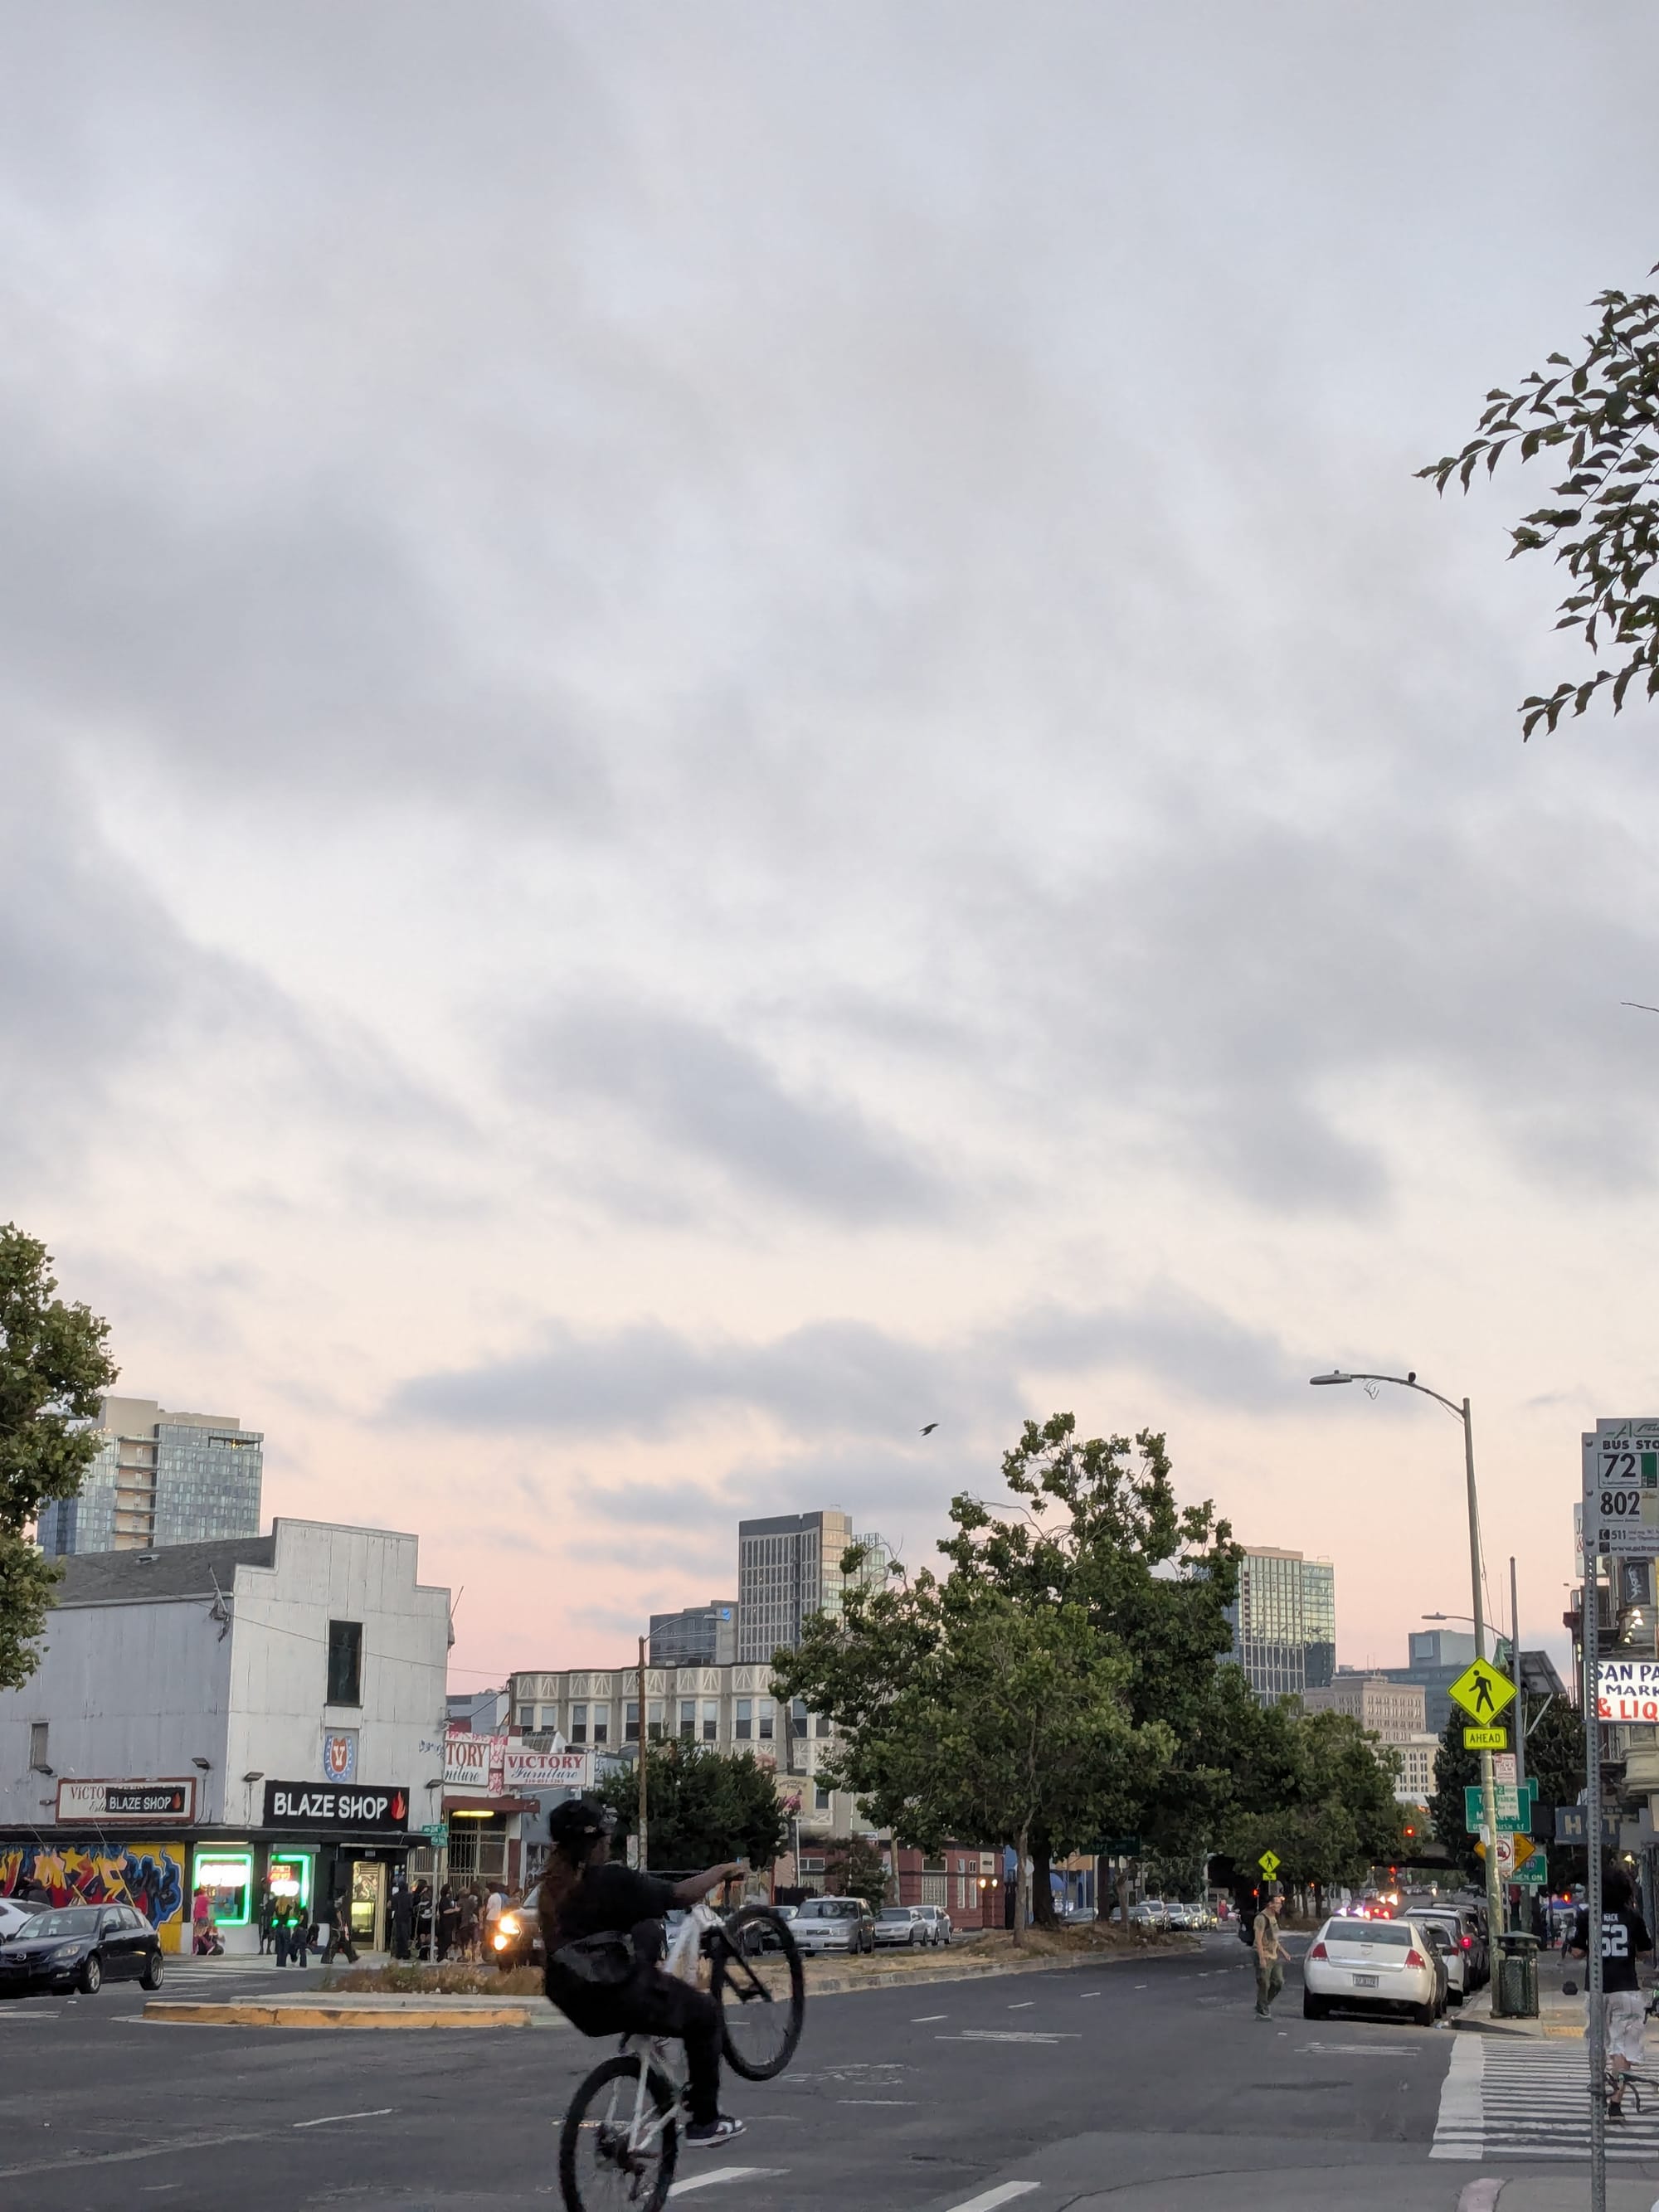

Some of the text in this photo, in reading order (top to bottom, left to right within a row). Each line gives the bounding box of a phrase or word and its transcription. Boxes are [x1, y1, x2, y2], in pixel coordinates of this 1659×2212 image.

[1603, 1440, 1659, 1450] BUS STO
[1603, 1453, 1636, 1477] 72
[1600, 1491, 1640, 1515] 802
[1611, 1530, 1626, 1540] 511
[1620, 1699, 1658, 1721] LIQ
[1470, 1733, 1501, 1743] AHEAD
[507, 1755, 585, 1769] VICTORY
[511, 1766, 578, 1779] Furniture
[71, 1785, 106, 1800] VICTO
[109, 1796, 172, 1810] BLAZE SHOP
[274, 1792, 388, 1821] BLAZE SHOP
[1601, 1924, 1627, 1957] 52
